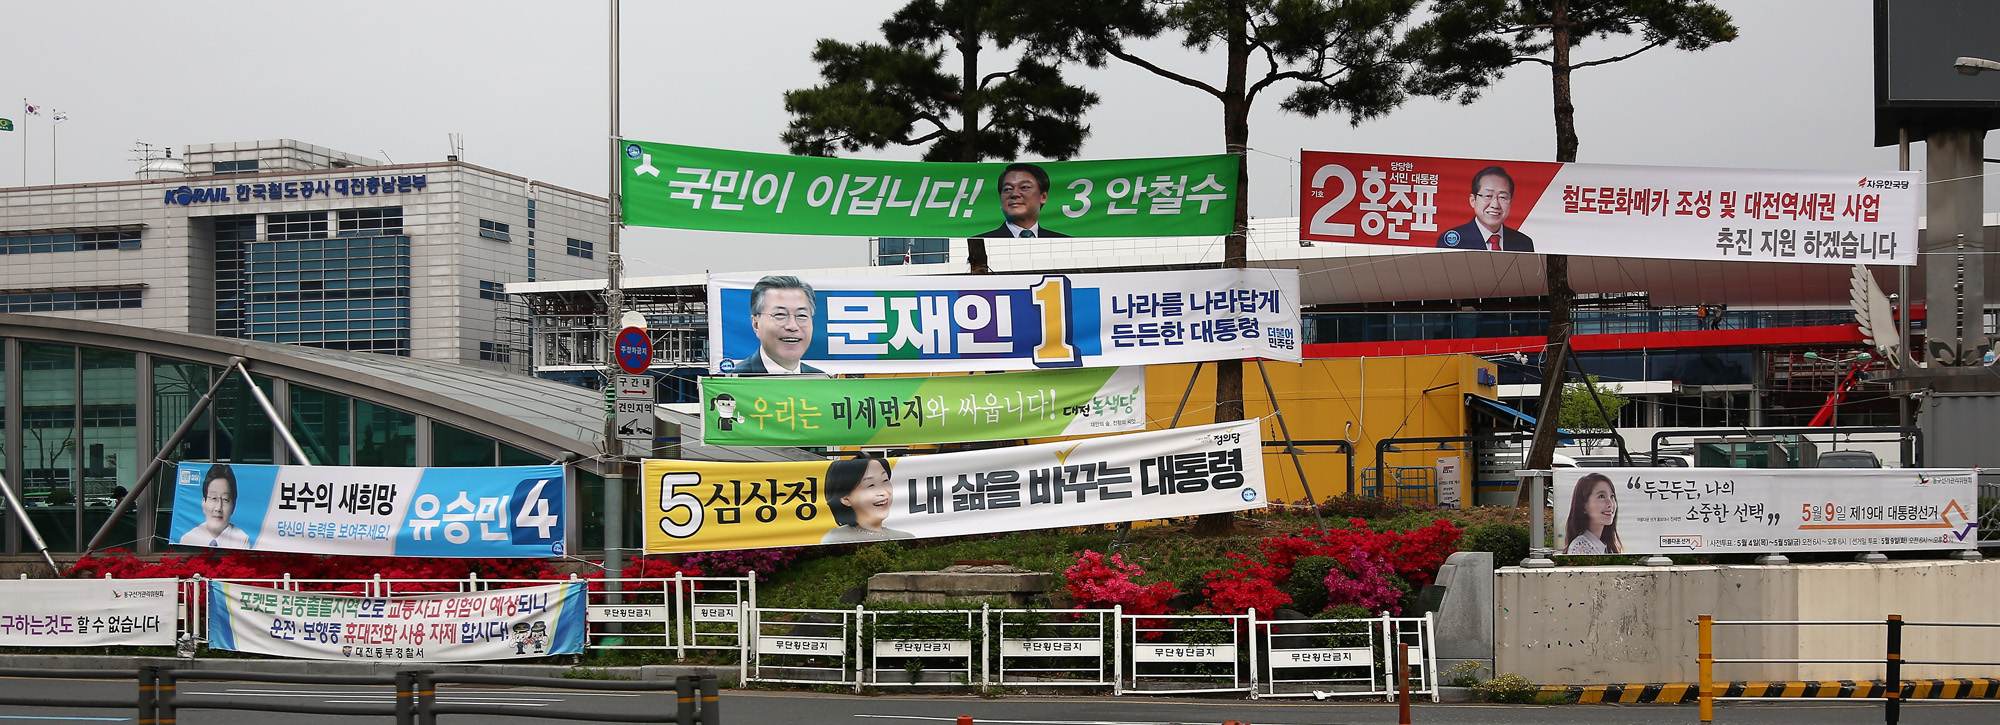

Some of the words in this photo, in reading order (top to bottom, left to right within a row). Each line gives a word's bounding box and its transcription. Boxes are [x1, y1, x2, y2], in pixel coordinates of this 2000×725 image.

[1390, 162, 1413, 172] 당당한
[235, 180, 331, 201] 한국철도공사
[334, 174, 427, 196] 대전충남본부
[1390, 173, 1408, 184] 서민
[1411, 174, 1439, 185] 대통령
[1866, 178, 1909, 189] 자유한국당
[164, 185, 230, 206] KORAIL
[668, 167, 795, 213] 국민이
[806, 173, 985, 218] 이깁니다!
[1062, 178, 1094, 218] 3
[1106, 173, 1228, 215] 안철수
[1309, 164, 1357, 237] 2
[1359, 166, 1438, 240] 홍준표
[1311, 190, 1324, 198] 기호
[1562, 184, 1669, 216] 철도문화메카
[1675, 189, 1712, 218] 조성
[1719, 190, 1737, 219] 및
[1744, 191, 1836, 221] 대전역세권
[1842, 193, 1880, 222] 사업
[1716, 227, 1753, 256] 추진
[1760, 228, 1796, 257] 지원
[1803, 230, 1897, 260] 하겠습니다
[1112, 291, 1184, 318] 나라를
[1190, 289, 1280, 316] 나라답게
[826, 293, 1013, 356] 문재인
[1032, 276, 1078, 364] 1
[1111, 320, 1185, 347] 든든한
[1190, 317, 1260, 343] 대통령
[1267, 327, 1294, 339] 더불어
[621, 345, 647, 355] 주정차금지
[1268, 337, 1294, 350] 민주당
[618, 403, 652, 414] 견인지역
[749, 397, 822, 430] 우리는
[831, 395, 949, 430] 미세먼지와
[957, 388, 1056, 425] 싸웁니다!
[1063, 404, 1090, 417] 대전
[1092, 394, 1136, 416] 녹색당
[1213, 433, 1240, 446] 정의당
[908, 475, 944, 515] 내
[951, 469, 1021, 512] 삶을
[1029, 461, 1133, 505] 바꾸는
[1140, 447, 1245, 496] 대통령
[1705, 479, 1735, 496] 나의
[278, 482, 333, 514] 보수의
[338, 483, 397, 515] 새희망
[659, 472, 705, 538] 5
[704, 477, 818, 524] 심상정
[409, 491, 510, 545] 유승민
[516, 479, 559, 539] 4
[1686, 502, 1729, 524] 소중한
[1801, 503, 1822, 522] 5월
[1824, 502, 1847, 522] 9일
[1850, 505, 1884, 521] 제19대
[1887, 505, 1938, 521] 대통령선거
[278, 521, 305, 538] 당신의
[307, 521, 336, 539] 능력을
[338, 523, 391, 542] 보여주세요!
[240, 591, 278, 614] 포켓몬
[281, 595, 387, 619] 집중출몰지역으로
[388, 599, 444, 620] 교통사고
[444, 597, 487, 618] 위험이
[489, 593, 548, 617] 예상되니
[603, 608, 652, 618] 무단횡단금지
[701, 608, 734, 618] 횡단금지
[1, 615, 74, 635] 구하는것도
[77, 616, 90, 633] 할
[92, 617, 105, 634] 수
[108, 615, 160, 634] 없습니다
[344, 622, 397, 645] 휴대전화
[399, 623, 426, 646] 사용
[429, 623, 457, 645] 자제
[461, 621, 509, 644] 합시다!
[355, 647, 424, 659] 대전동부경찰서
[776, 640, 828, 651] 무단횡단금지
[894, 642, 951, 652] 무단횡단금지
[1022, 642, 1082, 652] 무단횡단금지
[1154, 647, 1216, 658] 무단횡단금지
[1291, 652, 1352, 662] 무단횡단금지
